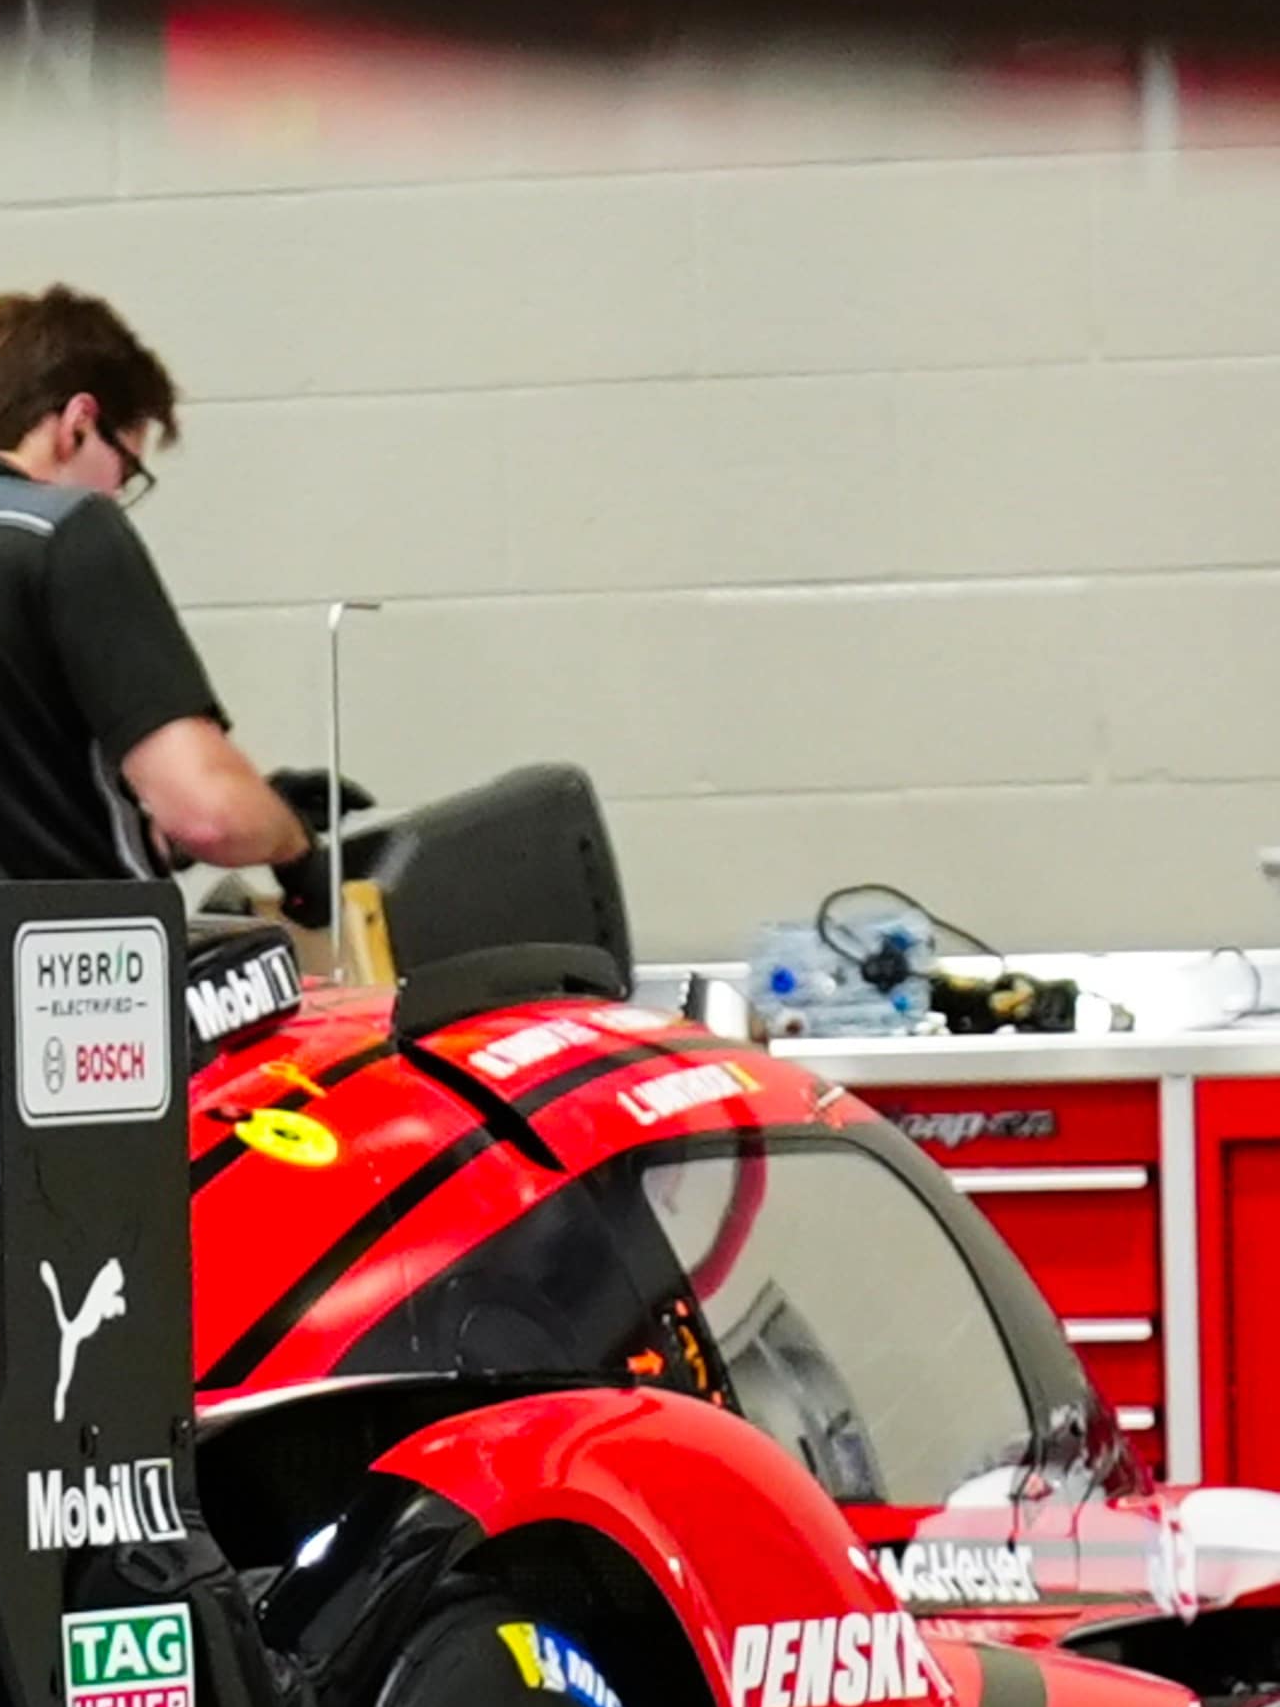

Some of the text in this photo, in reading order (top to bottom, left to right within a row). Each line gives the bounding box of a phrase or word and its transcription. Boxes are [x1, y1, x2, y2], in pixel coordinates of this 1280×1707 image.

[38, 943, 144, 989] HYBRID
[75, 1041, 146, 1084] BOSCH
[71, 1618, 185, 1681] TAG
